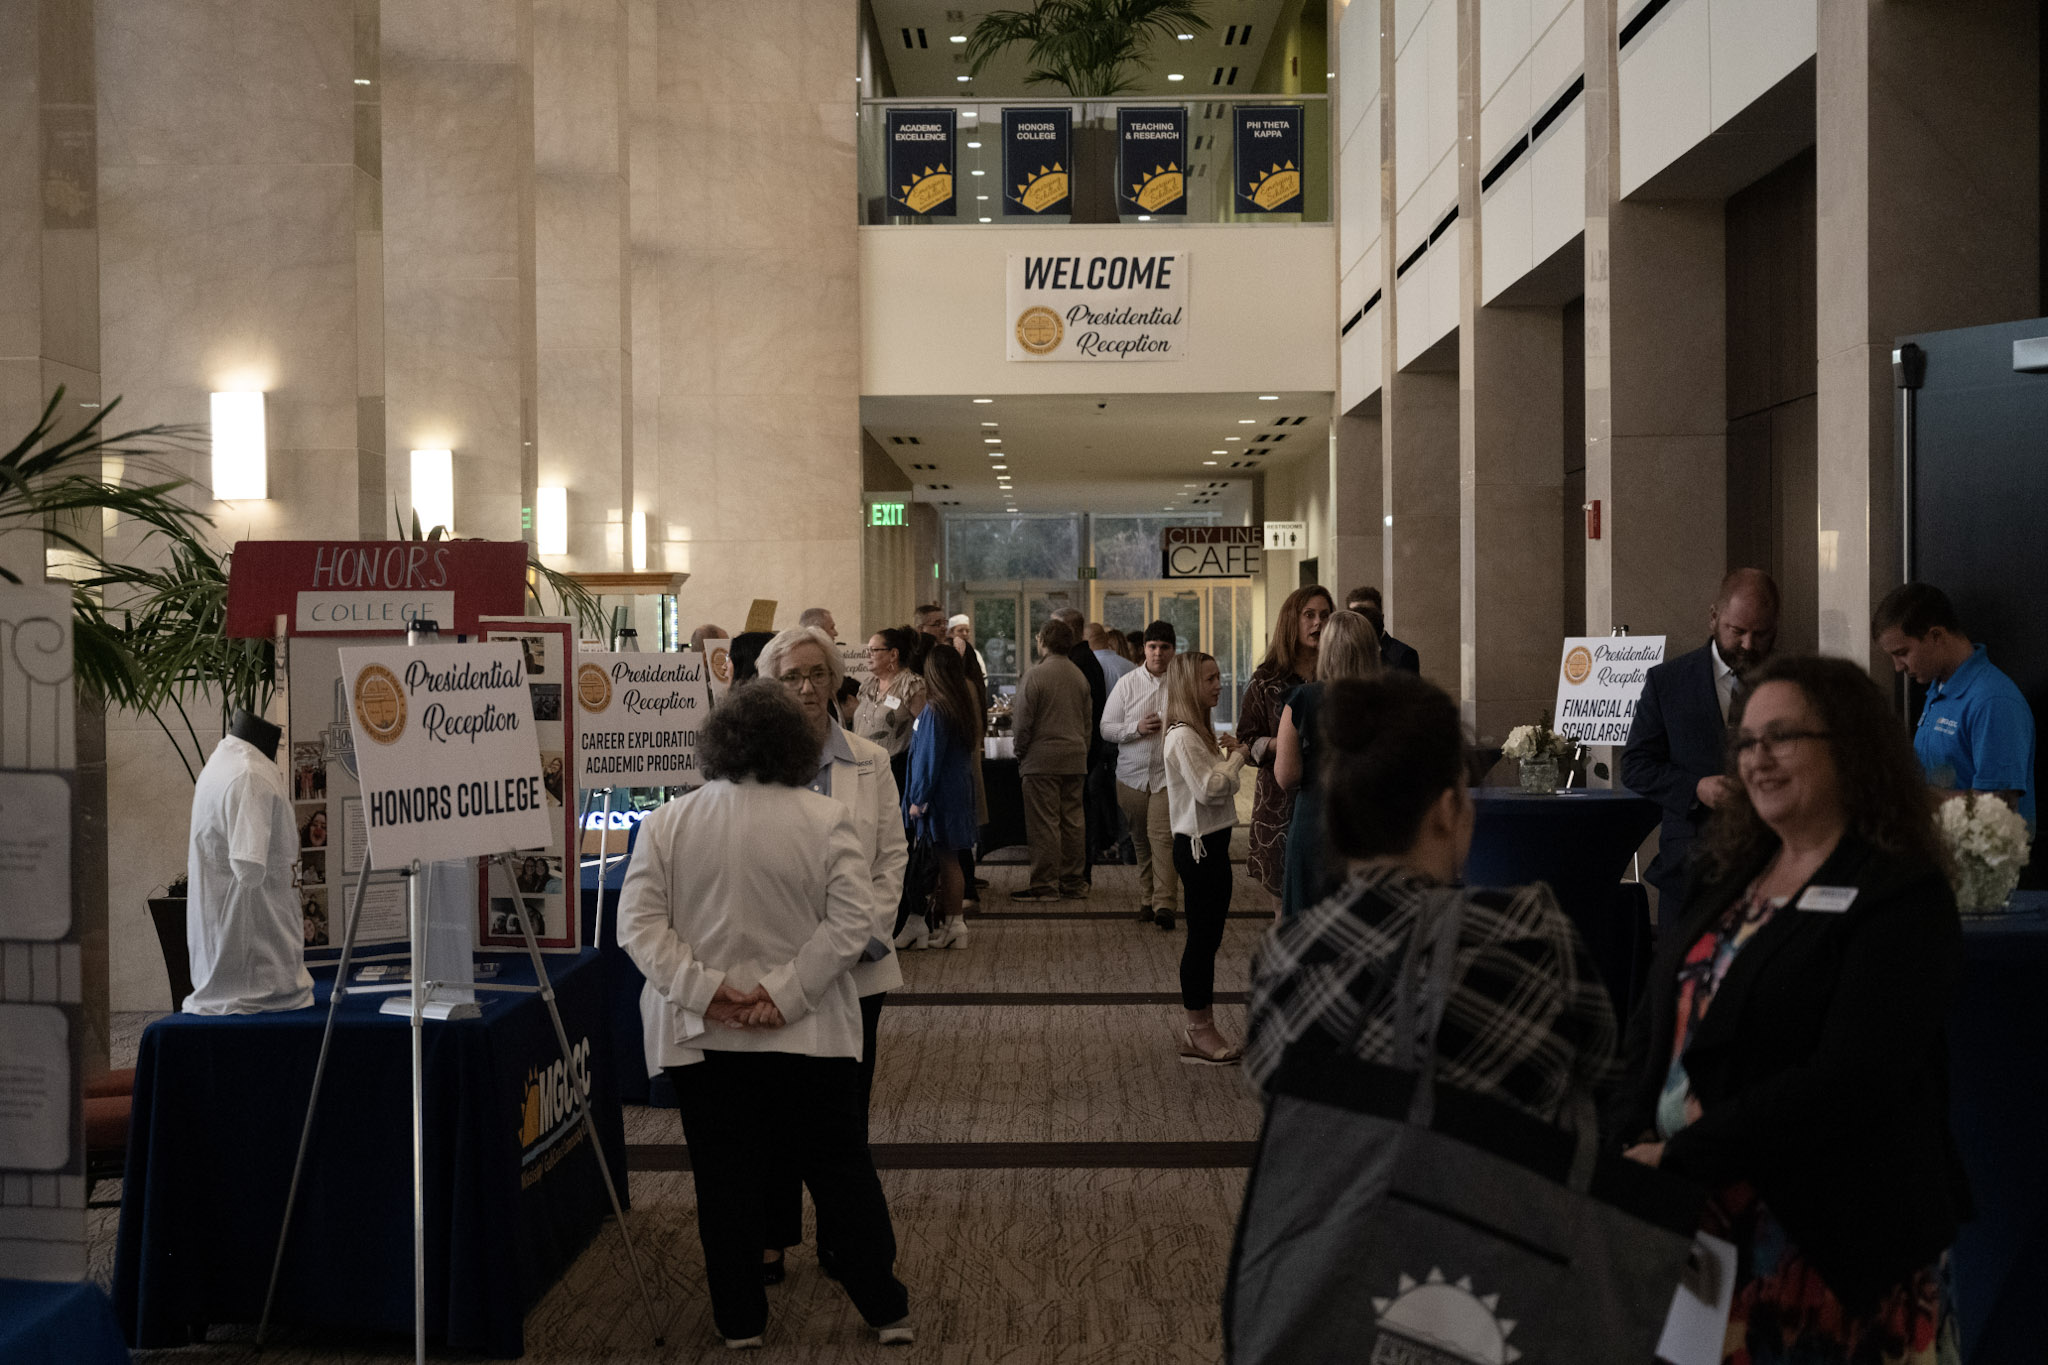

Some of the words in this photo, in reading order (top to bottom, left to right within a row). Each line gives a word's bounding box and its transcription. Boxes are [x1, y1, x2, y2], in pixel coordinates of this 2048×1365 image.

[899, 124, 942, 132] ACADEMIC
[1018, 123, 1055, 131] HONORS
[1130, 122, 1174, 131] TEACHING
[1246, 121, 1261, 129] PHI
[1262, 121, 1290, 129] THETA
[1254, 130, 1283, 138] KAPPA
[895, 133, 947, 141] EXCELLENCE
[1016, 132, 1057, 140] COLLEGE
[1125, 132, 1132, 140] &
[1133, 132, 1180, 140] RESEARCH
[1025, 256, 1175, 290] WELCOME
[1066, 304, 1182, 327] Presidential
[1076, 331, 1172, 359] Reception
[872, 504, 905, 526] EXIT
[1169, 528, 1213, 544] CITY
[1220, 528, 1262, 544] LINE
[312, 546, 450, 589] HONORS
[1170, 546, 1260, 574] CAFE
[311, 603, 434, 621] COLLEGE
[1594, 644, 1663, 663] Presidential
[405, 659, 524, 696] Presidential
[611, 662, 701, 684] Presidential
[623, 689, 698, 716] Reception
[1562, 699, 1621, 718] FINANCIAL
[422, 703, 520, 744] Reception
[1561, 722, 1630, 742] SCHOLARSH
[581, 732, 625, 750] CAREER
[585, 755, 644, 774] ACADEMIC
[647, 753, 696, 771] PROGRA
[370, 785, 451, 828] HONORS
[458, 776, 540, 818] COLLEGE
